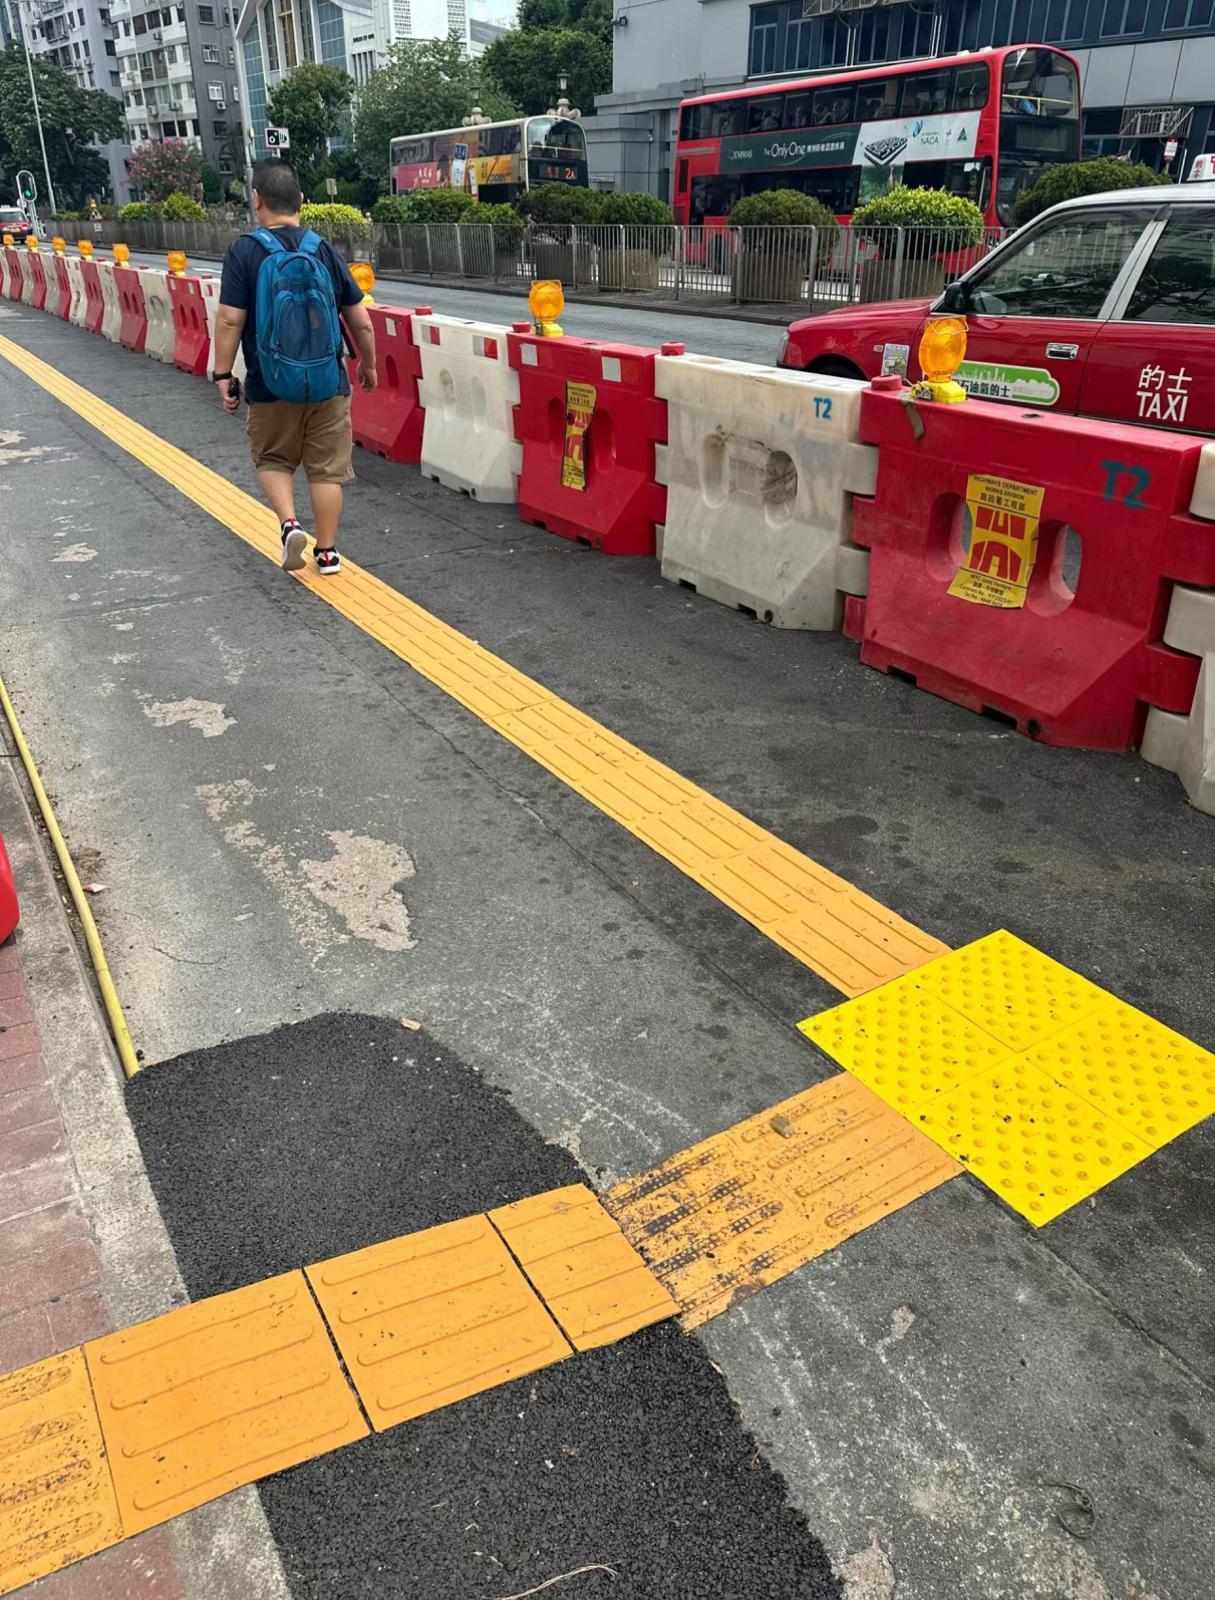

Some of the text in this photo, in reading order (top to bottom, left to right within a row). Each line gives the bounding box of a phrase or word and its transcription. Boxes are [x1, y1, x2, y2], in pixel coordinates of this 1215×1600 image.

[564, 167, 576, 180] 2A
[954, 379, 1011, 398] 石油氣的士
[1138, 364, 1193, 394] 的士
[813, 396, 832, 419] T2
[1136, 391, 1188, 422] TAXI
[973, 475, 1038, 495] HIGHWAYS DEPARTMENT
[985, 486, 1025, 500] WORKS DIVISION
[1101, 460, 1150, 509] T2
